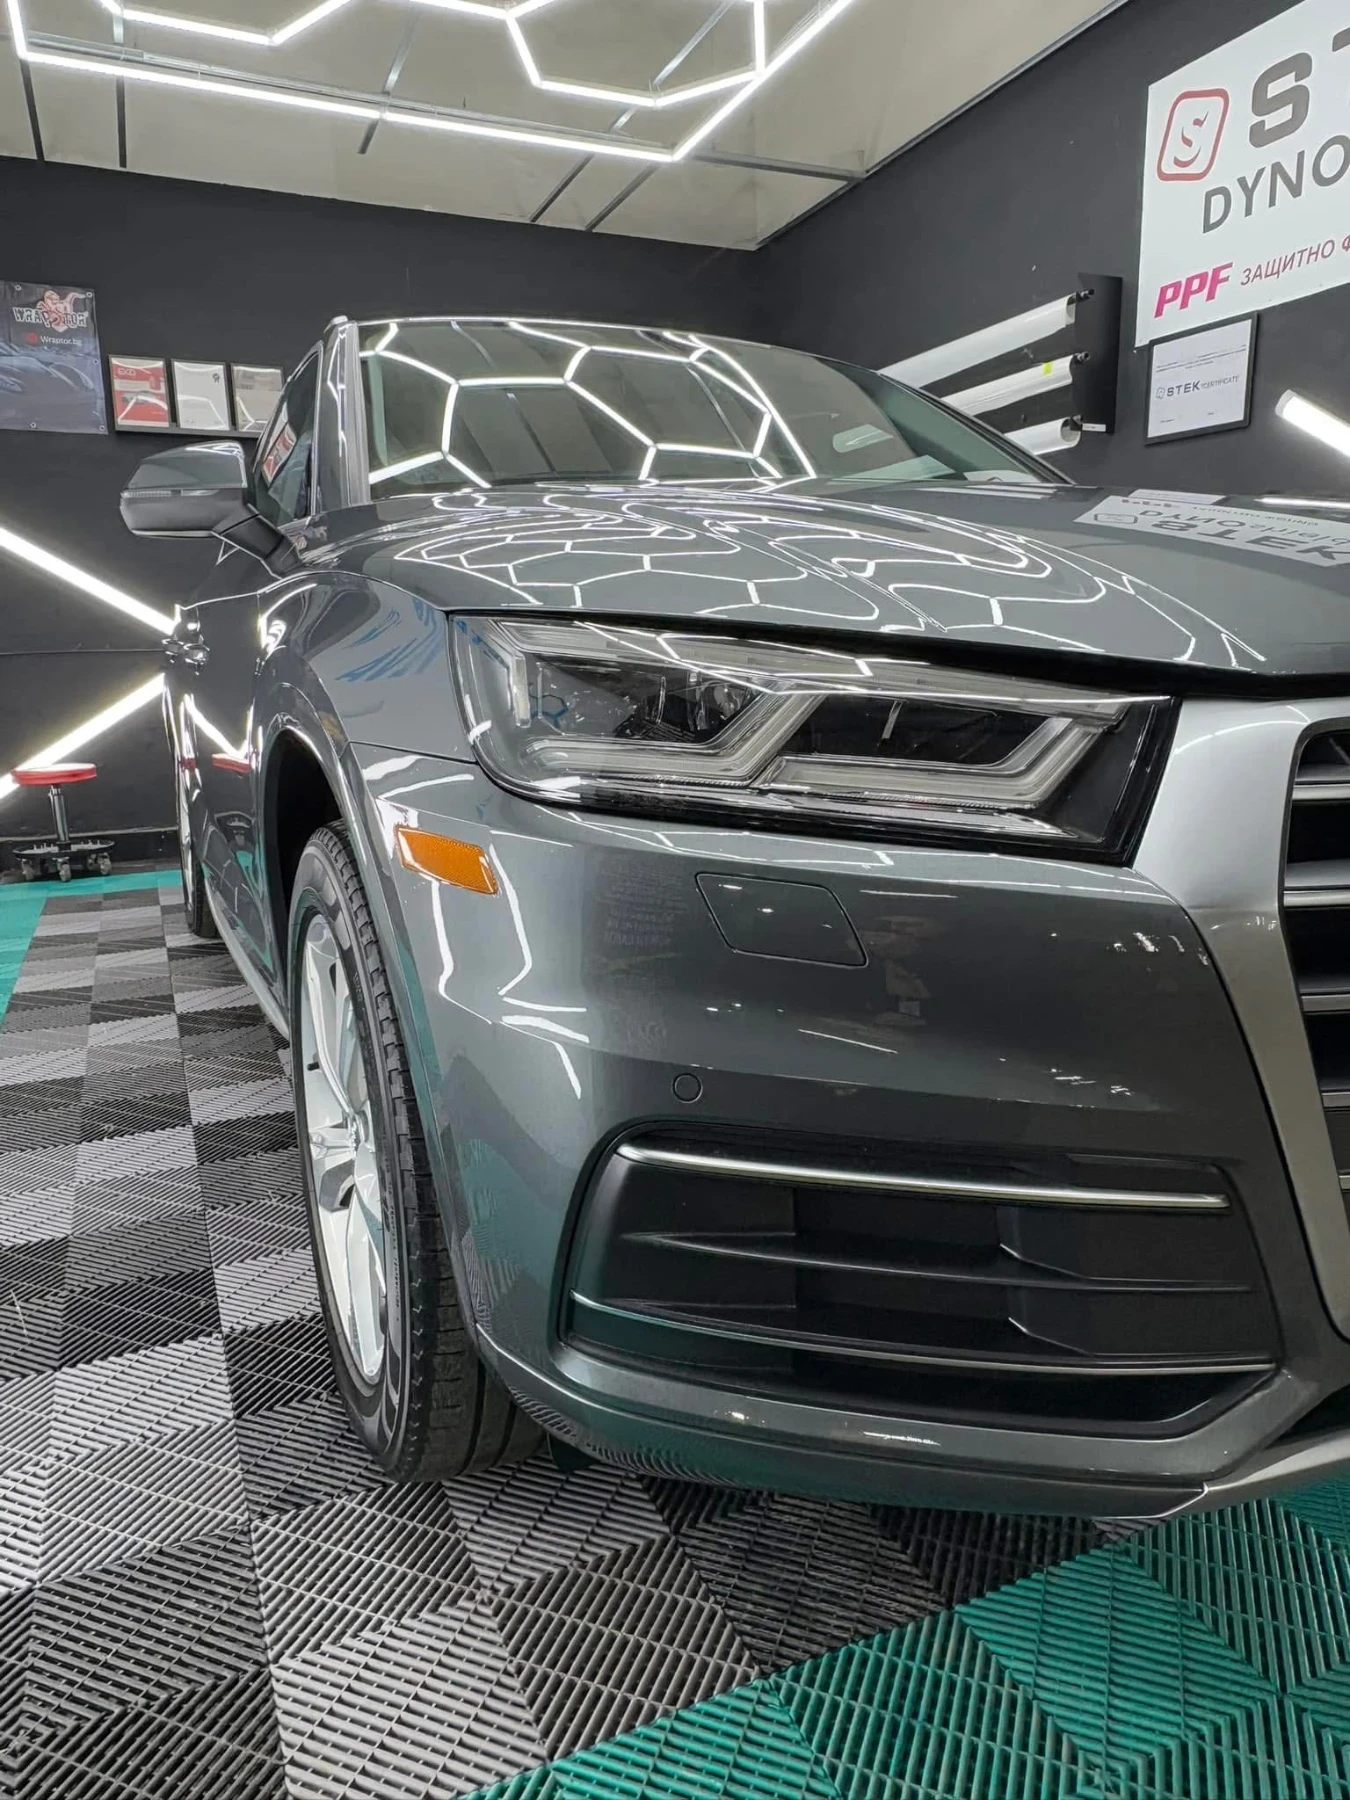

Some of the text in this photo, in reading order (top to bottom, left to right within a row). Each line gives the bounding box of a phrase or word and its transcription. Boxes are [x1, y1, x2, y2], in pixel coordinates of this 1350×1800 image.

[1249, 27, 1350, 148] S
[1154, 239, 1335, 318] PPF ЗАЩИТНО
[1166, 380, 1200, 397] STEK
